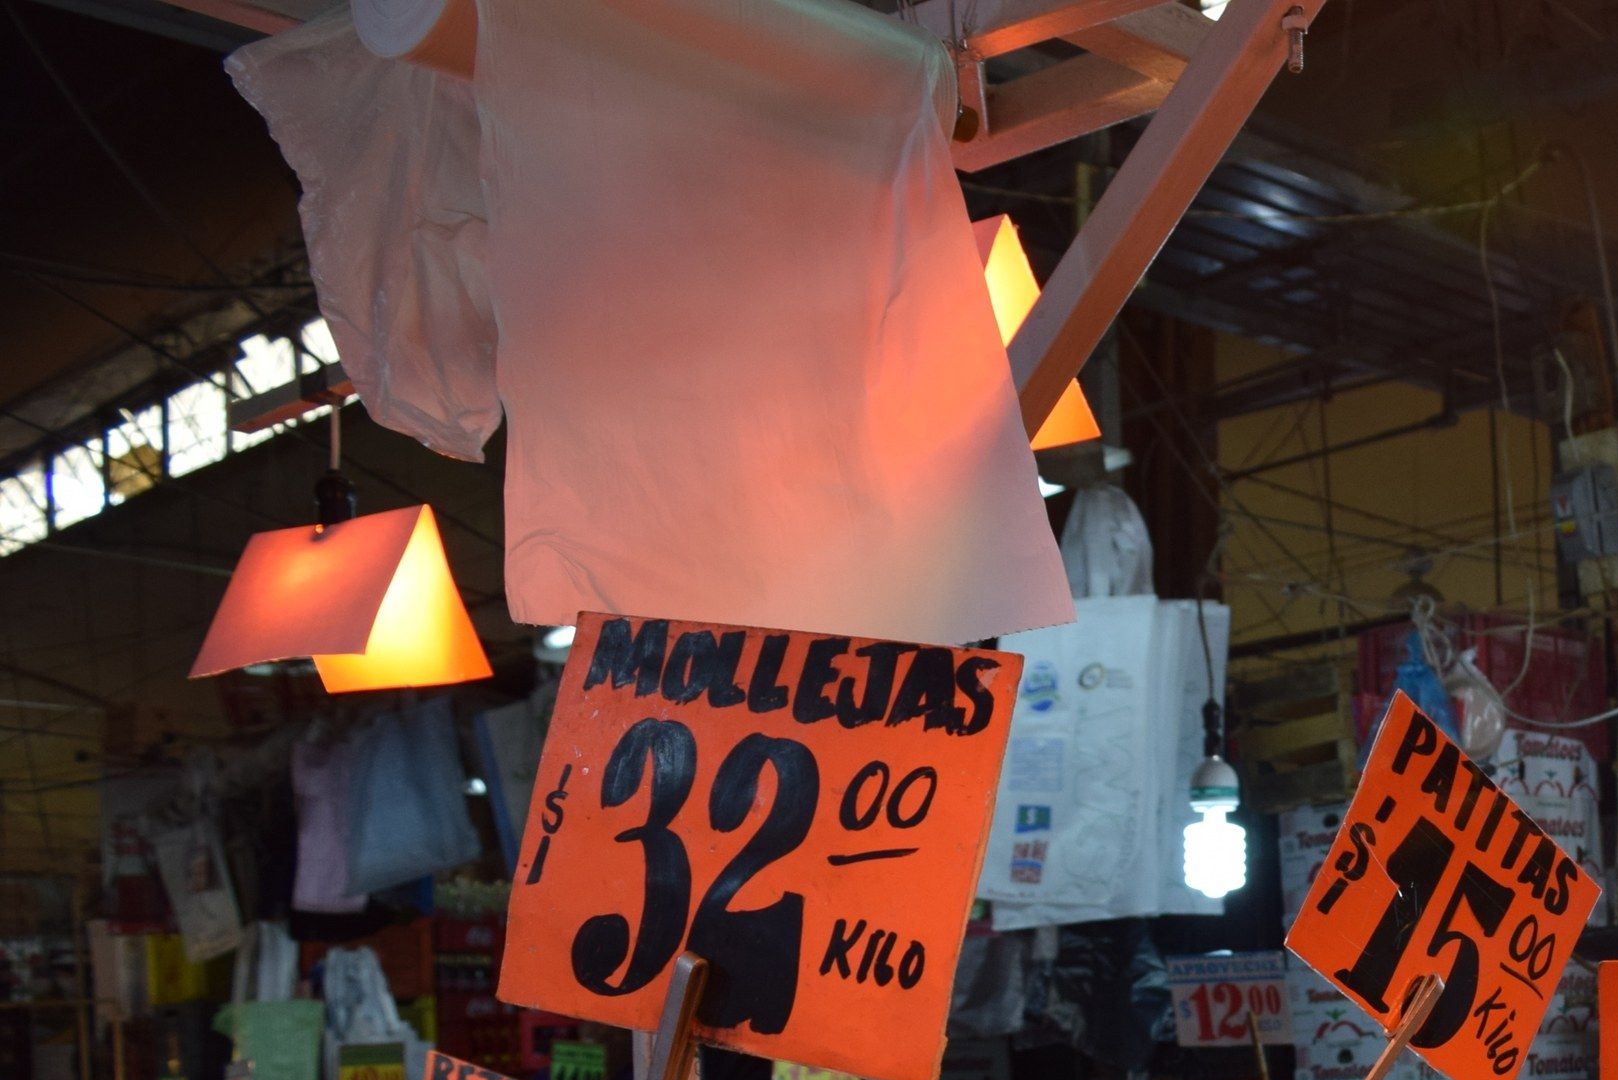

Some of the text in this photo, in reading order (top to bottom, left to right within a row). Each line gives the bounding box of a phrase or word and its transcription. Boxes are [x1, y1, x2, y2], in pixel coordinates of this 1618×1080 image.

[584, 617, 1001, 736] MOLLEJAS
[525, 763, 572, 885] $
[571, 718, 820, 1034] 32
[839, 760, 938, 831] 00
[1392, 711, 1578, 915] PATITAS
[1190, 982, 1248, 1041] 12
[1248, 984, 1281, 1016] 00
[1316, 796, 1556, 1049] $ 15 00
